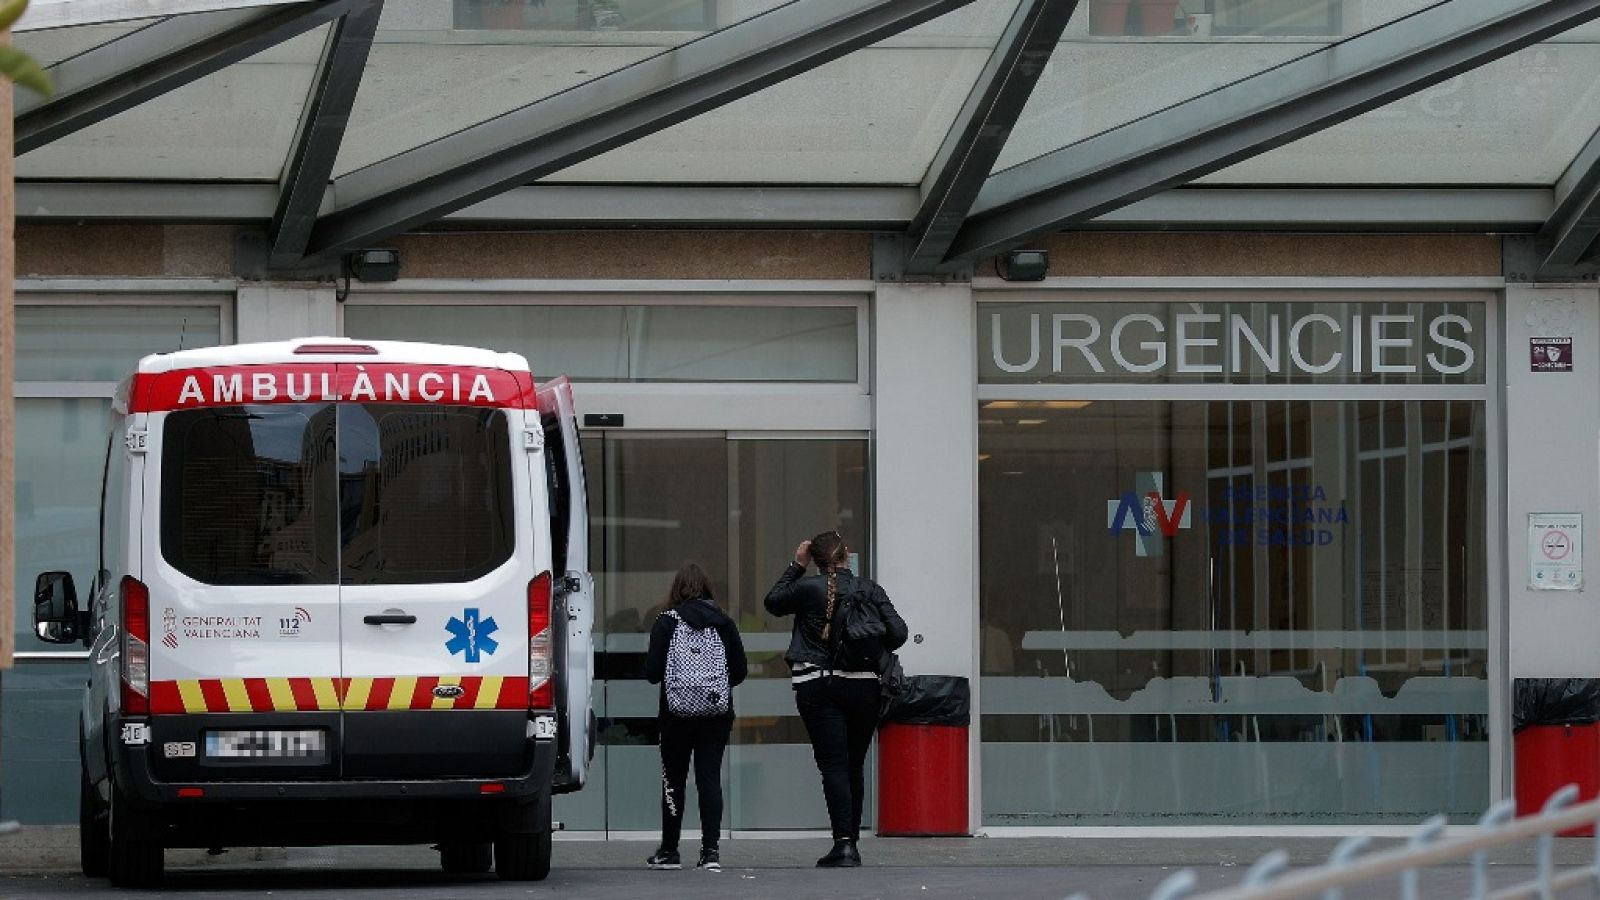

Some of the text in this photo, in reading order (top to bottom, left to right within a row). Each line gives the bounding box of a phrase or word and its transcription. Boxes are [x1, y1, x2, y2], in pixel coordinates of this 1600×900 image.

[990, 303, 1475, 375] URGÈNCIES
[177, 365, 495, 404] AMBULÀNCIA
[182, 616, 262, 626] GENERALITAT
[279, 618, 299, 629] 112
[183, 629, 260, 638] VALENCIANA
[165, 743, 194, 756] SP
